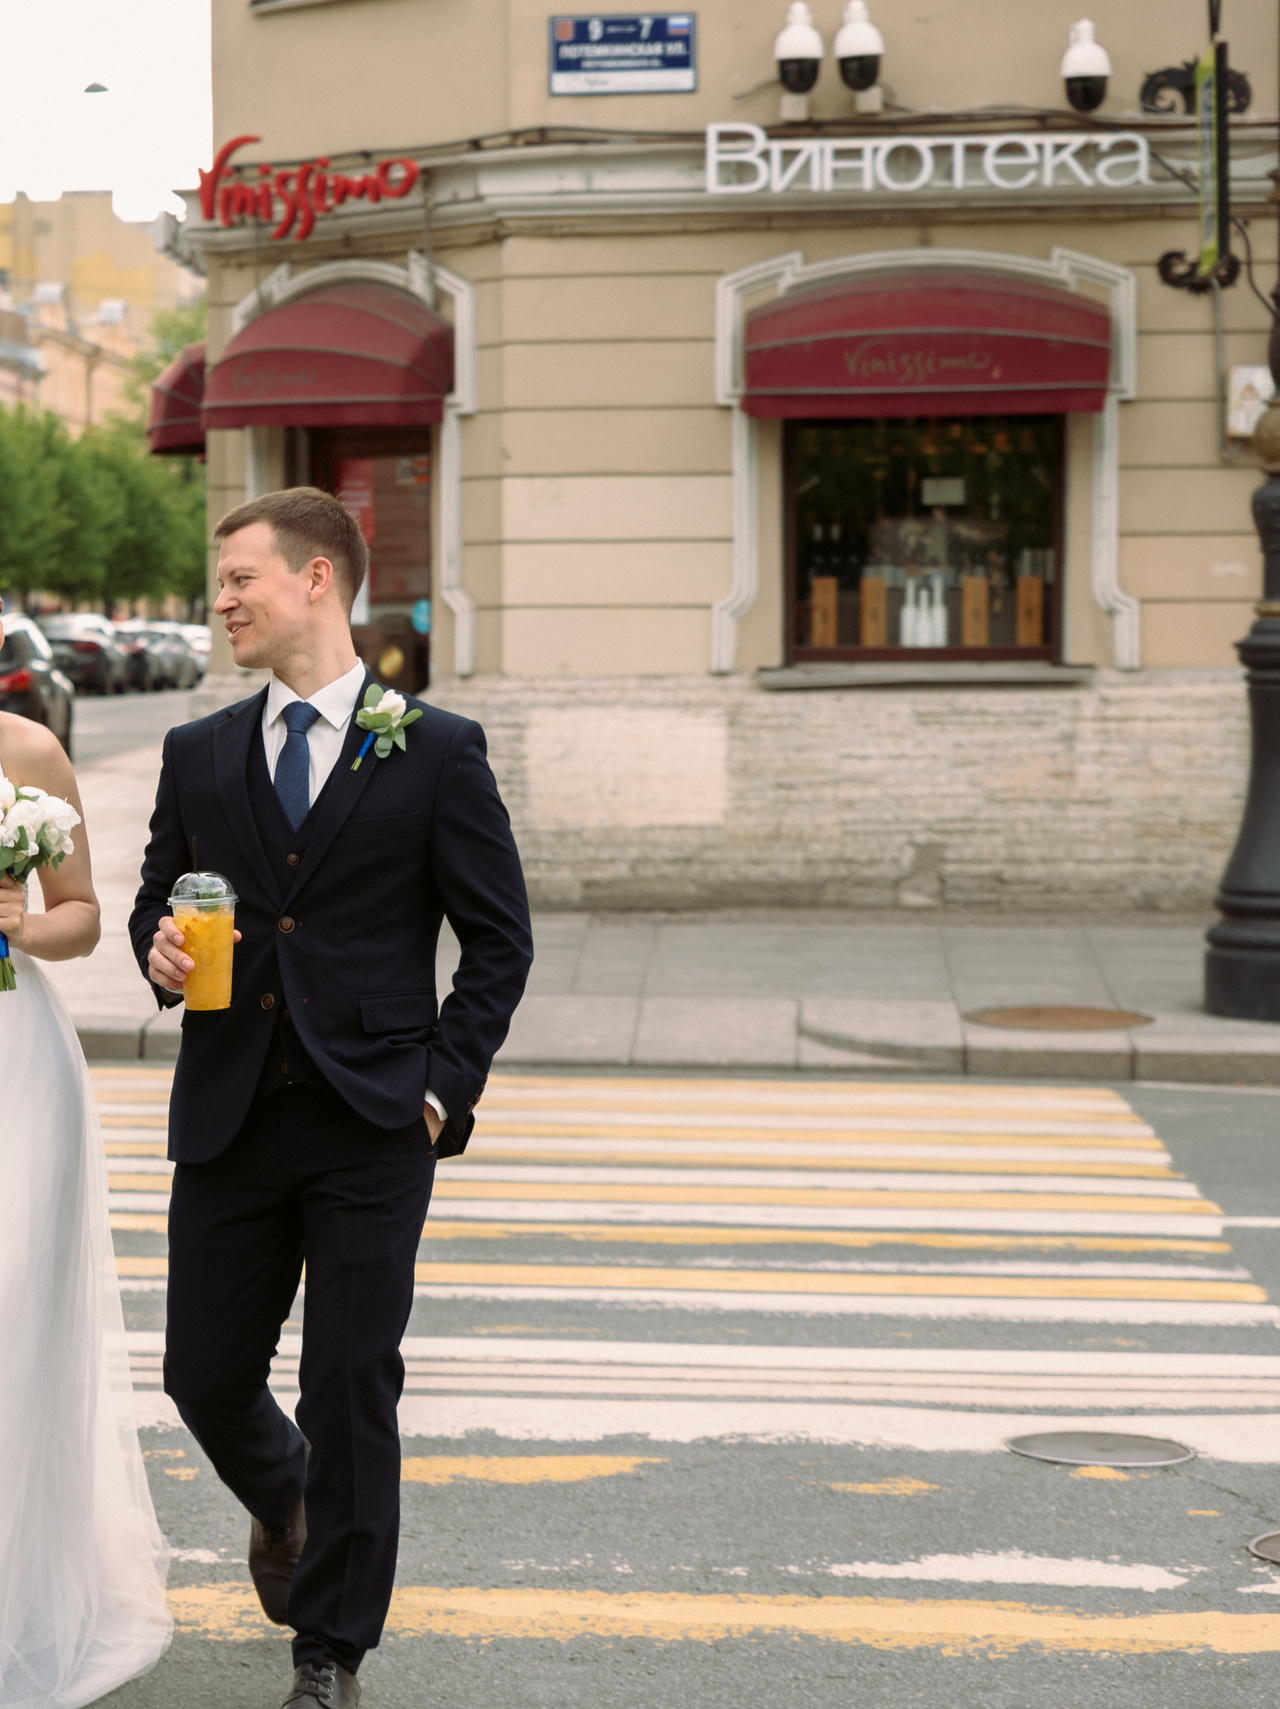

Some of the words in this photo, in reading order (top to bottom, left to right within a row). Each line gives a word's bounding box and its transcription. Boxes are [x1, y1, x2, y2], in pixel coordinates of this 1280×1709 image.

[588, 18, 604, 41] 9
[639, 18, 654, 39] 7
[197, 134, 420, 241] Vinissimo
[705, 122, 1156, 195] Винотека
